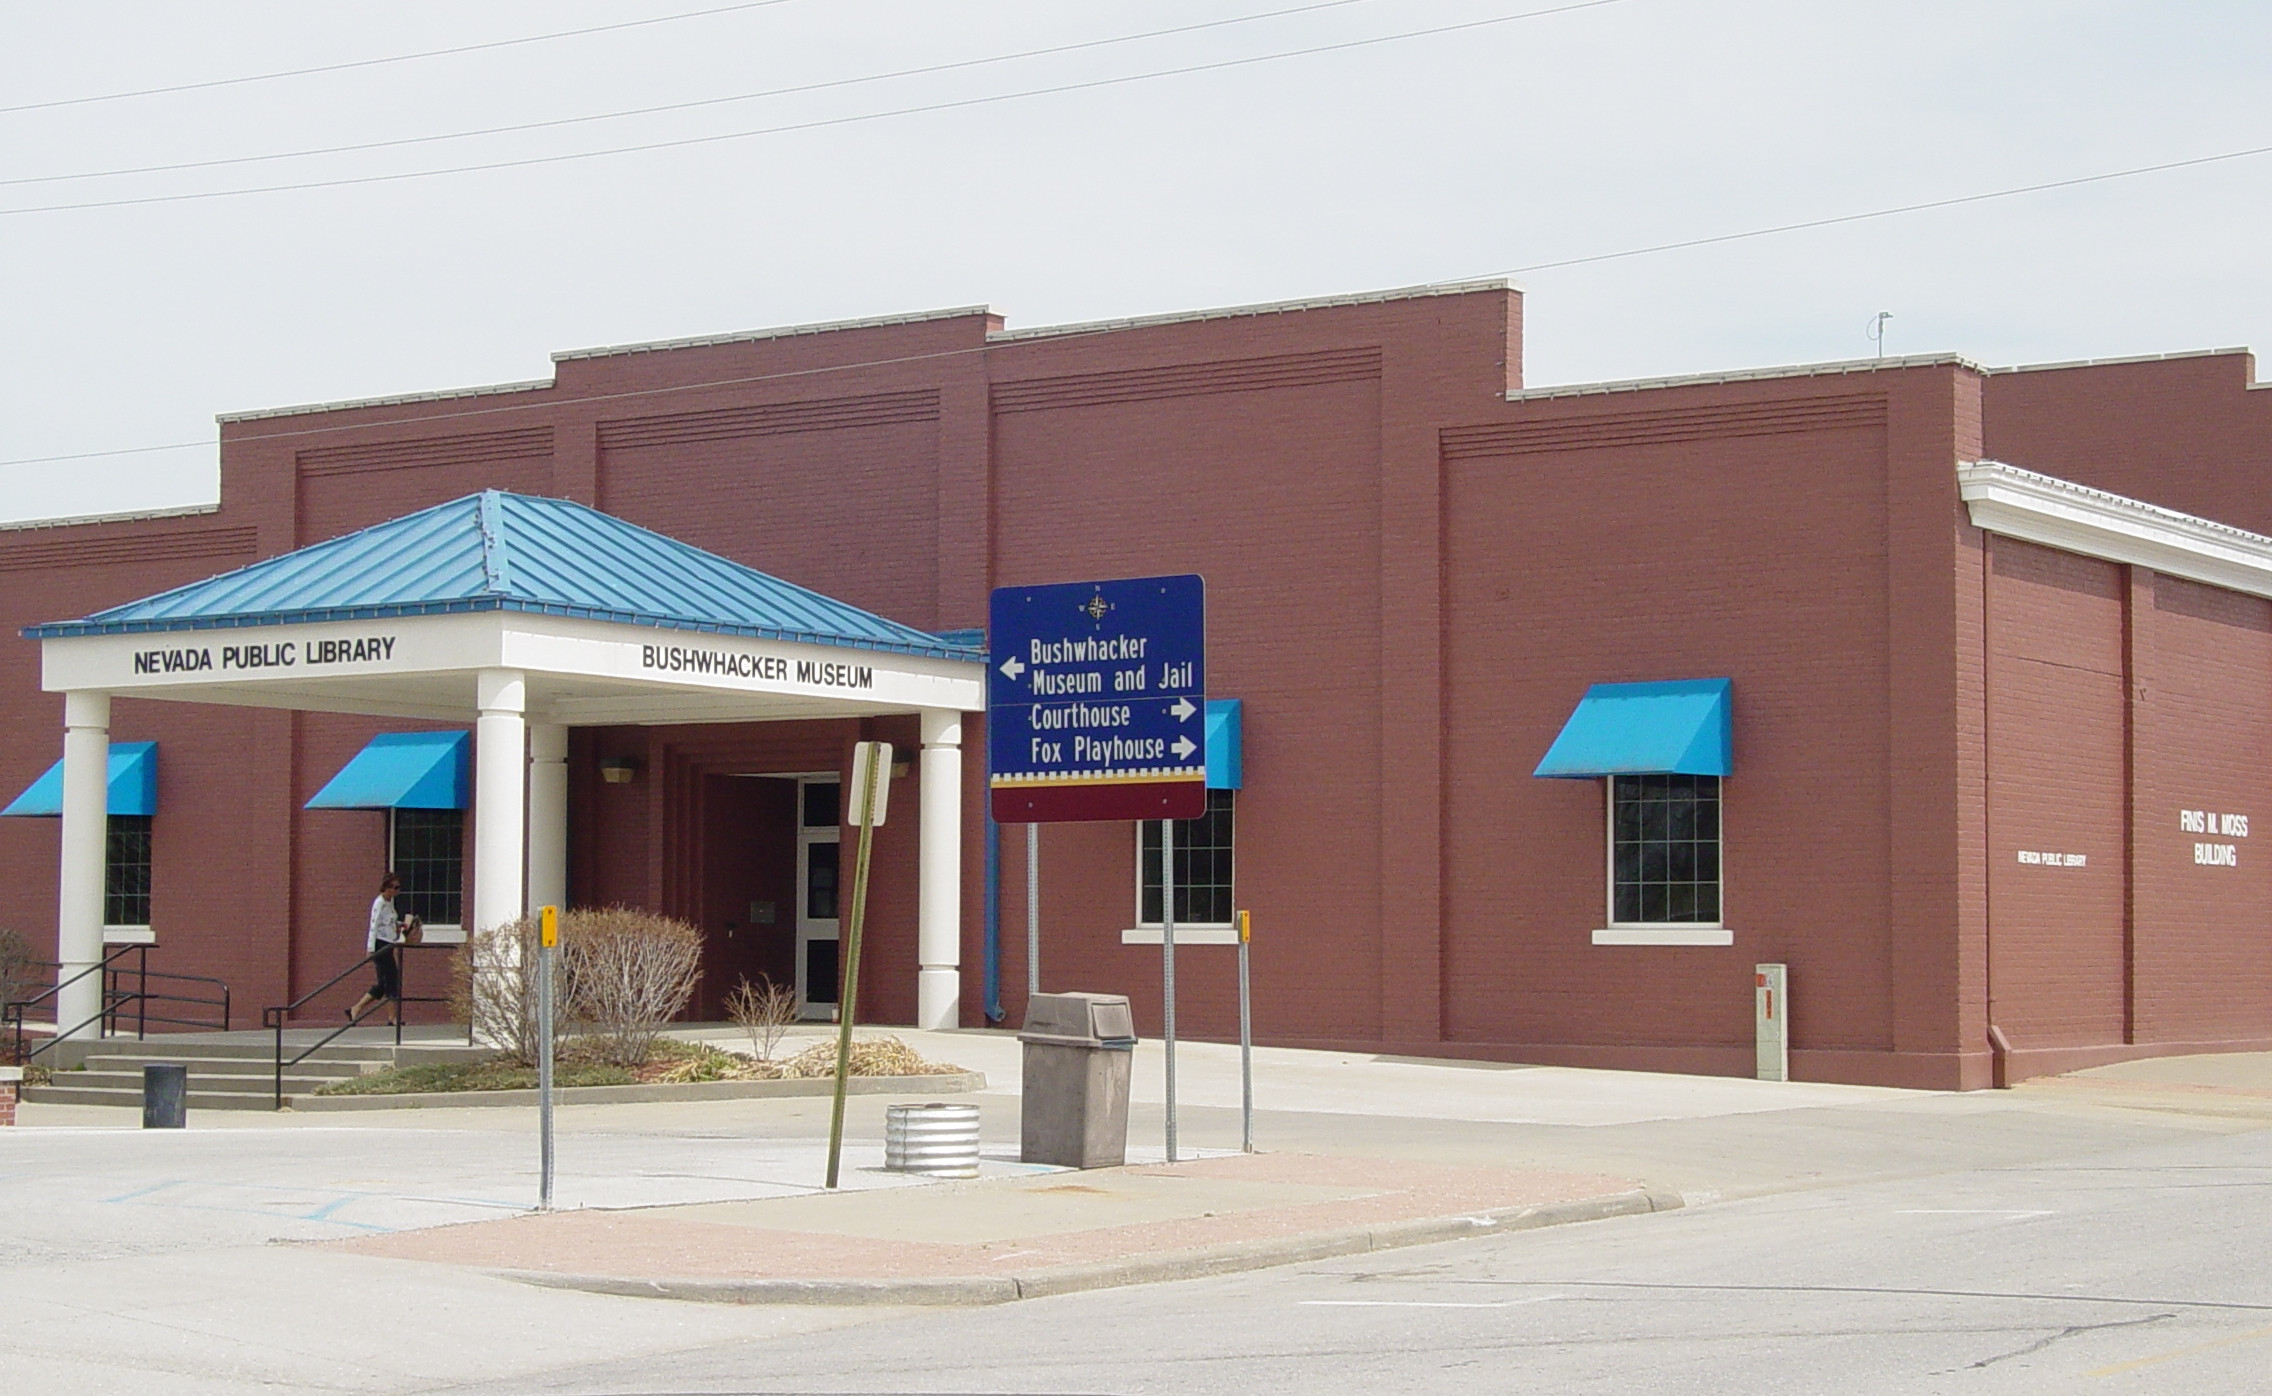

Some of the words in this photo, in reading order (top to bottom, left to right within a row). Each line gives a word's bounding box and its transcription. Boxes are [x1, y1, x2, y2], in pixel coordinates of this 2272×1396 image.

[135, 648, 213, 675] NEVADA
[222, 642, 296, 670] PUBLIC
[306, 636, 396, 664] LIBRARY
[1030, 634, 1148, 665] Bushwhacker
[642, 645, 788, 681] BUSHWHACKER
[796, 660, 874, 690] MUSEUM
[1032, 667, 1102, 696] Museum
[1114, 663, 1145, 691] and
[1158, 661, 1193, 689] Jail
[1031, 701, 1131, 731] Courthouse
[1031, 737, 1062, 764] Fox
[1074, 735, 1165, 768] Playhouse
[2180, 809, 2205, 834] FINIS
[2221, 813, 2249, 838] MOSS
[2017, 850, 2041, 865] NEVADA
[2041, 852, 2063, 867] PUBLIC
[2063, 853, 2087, 867] LIBRARY
[2194, 842, 2237, 867] BUILDING
